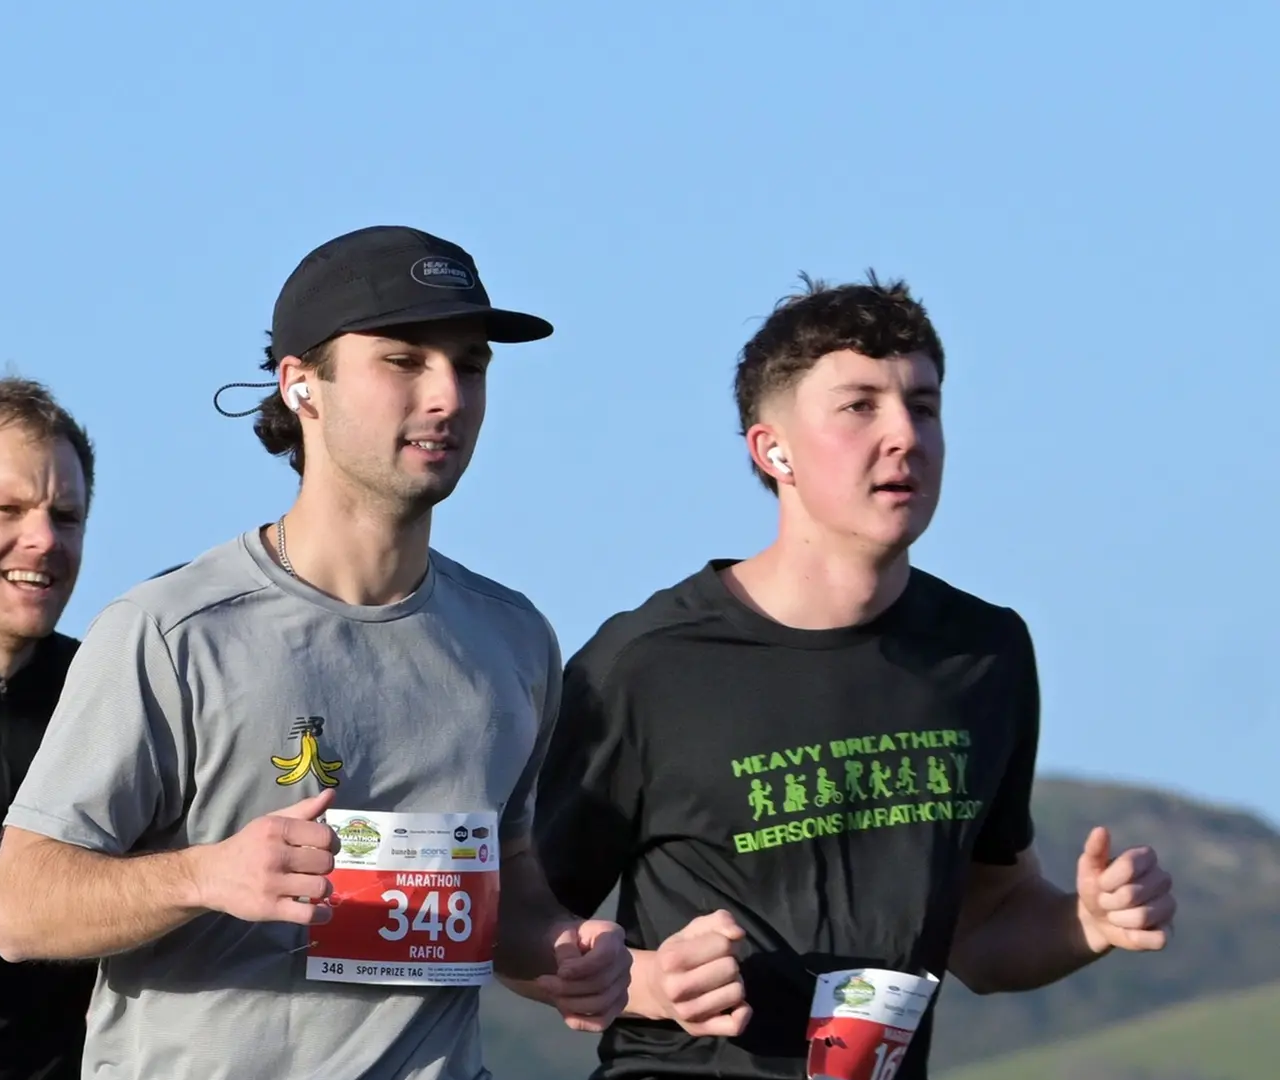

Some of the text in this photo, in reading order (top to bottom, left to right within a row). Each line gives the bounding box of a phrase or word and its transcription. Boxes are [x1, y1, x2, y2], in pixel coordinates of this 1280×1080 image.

[731, 730, 972, 777] HEAVY BREATHERS
[733, 813, 844, 854] EMERSONS
[847, 801, 952, 831] MARATHON
[396, 873, 461, 888] MARATHON
[378, 890, 472, 942] 348
[409, 946, 445, 960] RAFIQ
[321, 962, 344, 975] 348
[356, 966, 378, 975] SPOT
[380, 966, 405, 976] PRIZE
[408, 967, 423, 977] TAG
